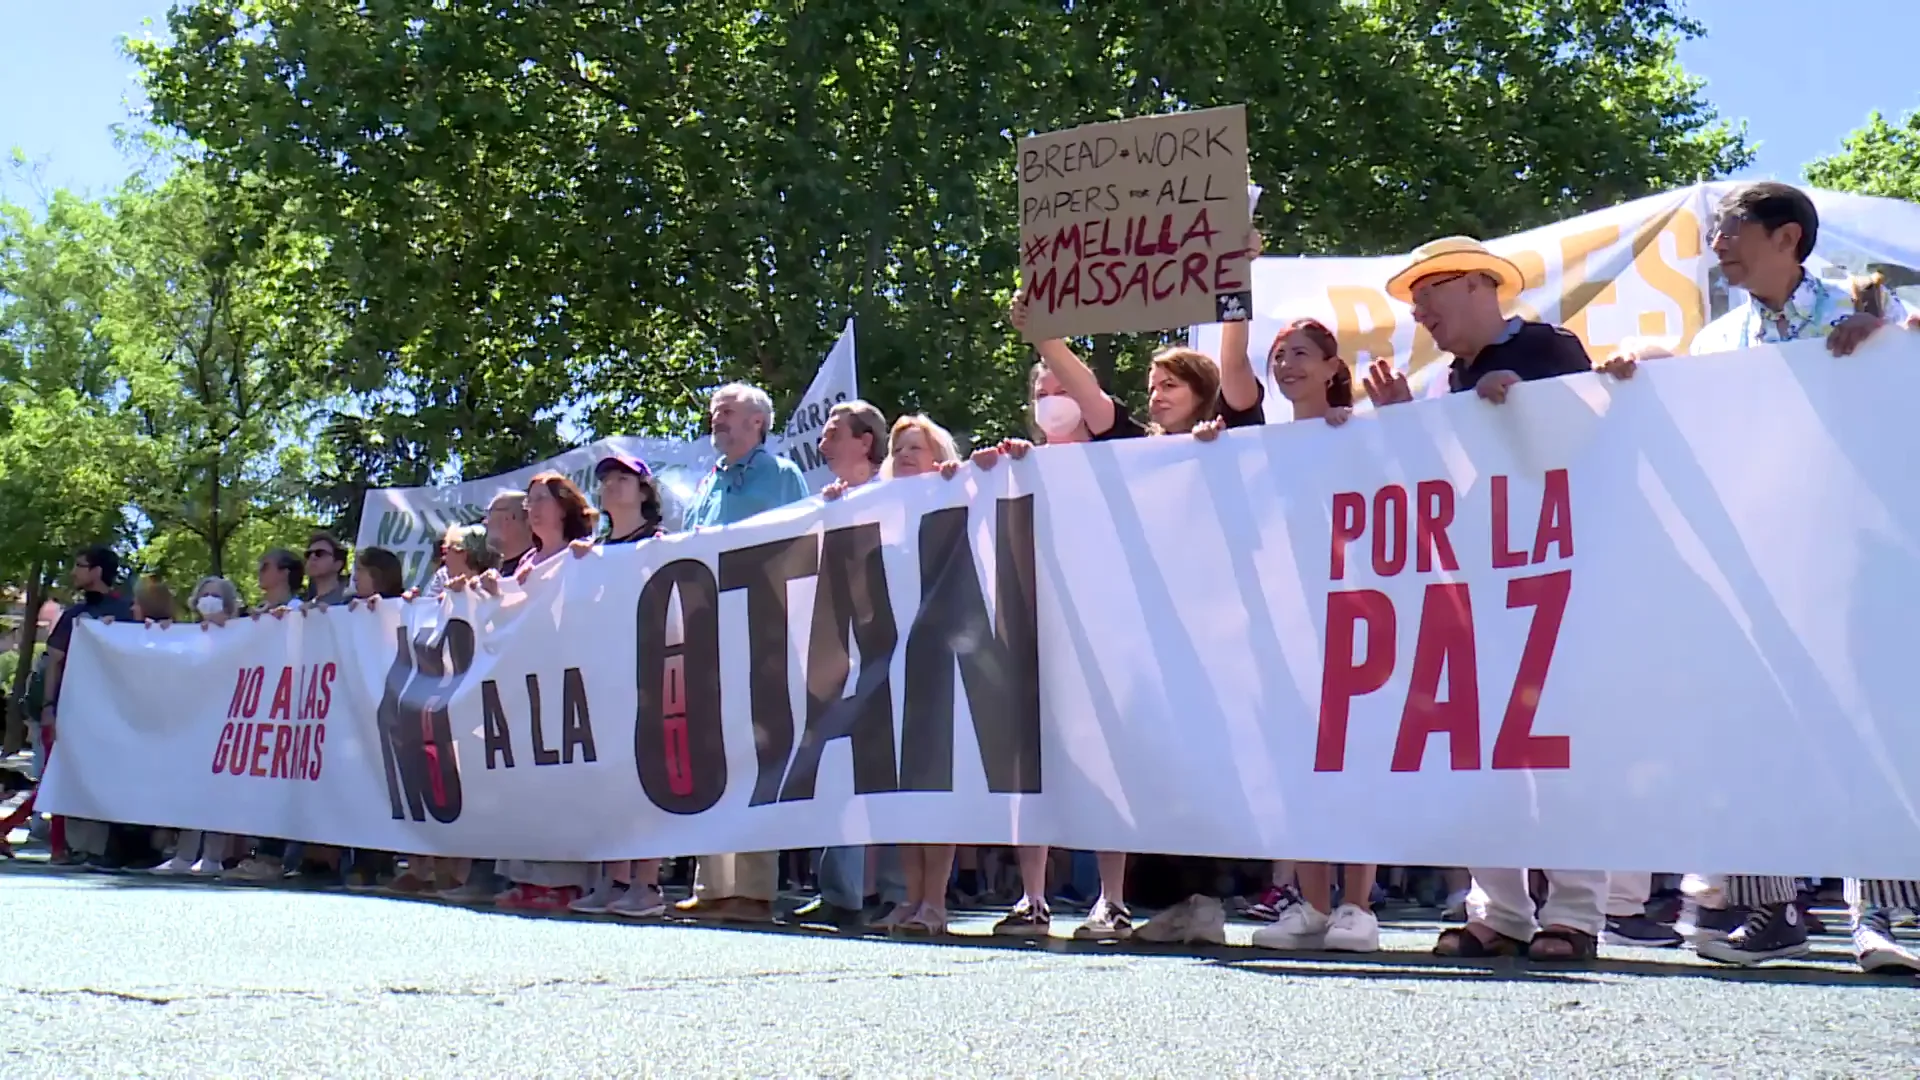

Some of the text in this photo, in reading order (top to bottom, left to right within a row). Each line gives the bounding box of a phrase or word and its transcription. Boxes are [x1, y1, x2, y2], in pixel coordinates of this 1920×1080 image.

[1023, 184, 1120, 225] PAPERS
[1156, 174, 1228, 206] ALL
[1024, 207, 1221, 266] #MELILLA
[1023, 249, 1249, 314] MASSACRE
[377, 510, 414, 546] NO
[1330, 468, 1575, 581] POR LA
[377, 493, 1042, 824] NO A LA OTAN
[1313, 569, 1573, 773] PAZ
[227, 662, 336, 720] NO A LAS
